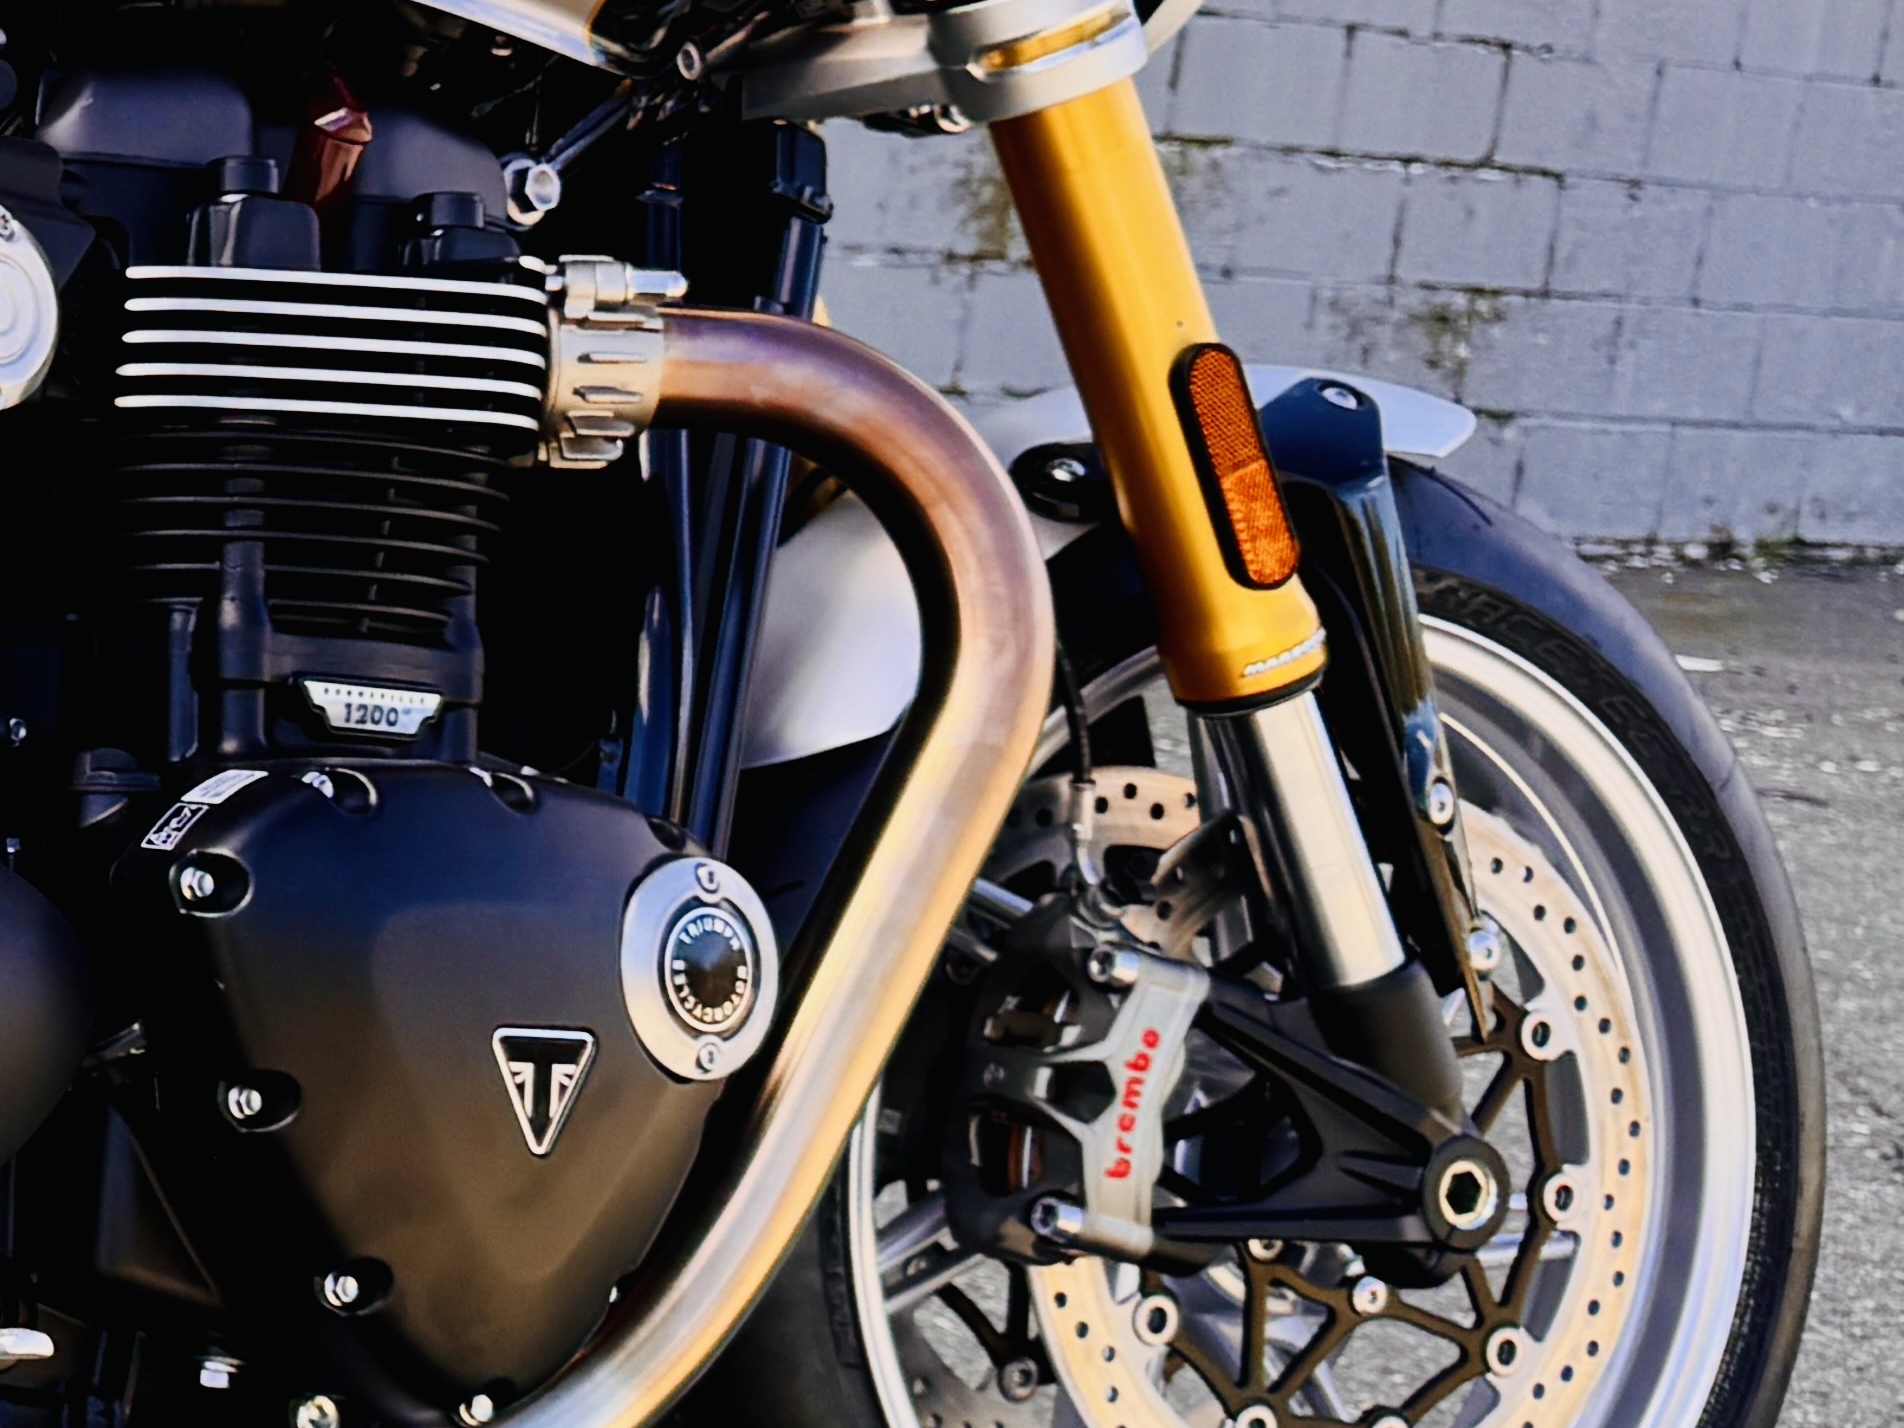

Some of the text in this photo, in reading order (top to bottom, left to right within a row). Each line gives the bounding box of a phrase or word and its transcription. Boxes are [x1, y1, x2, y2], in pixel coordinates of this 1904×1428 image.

[344, 703, 399, 727] 1200
[679, 917, 741, 951] TRIUMPH
[672, 959, 747, 1023] MOTORCYCLES
[1105, 1028, 1161, 1179] brembo
